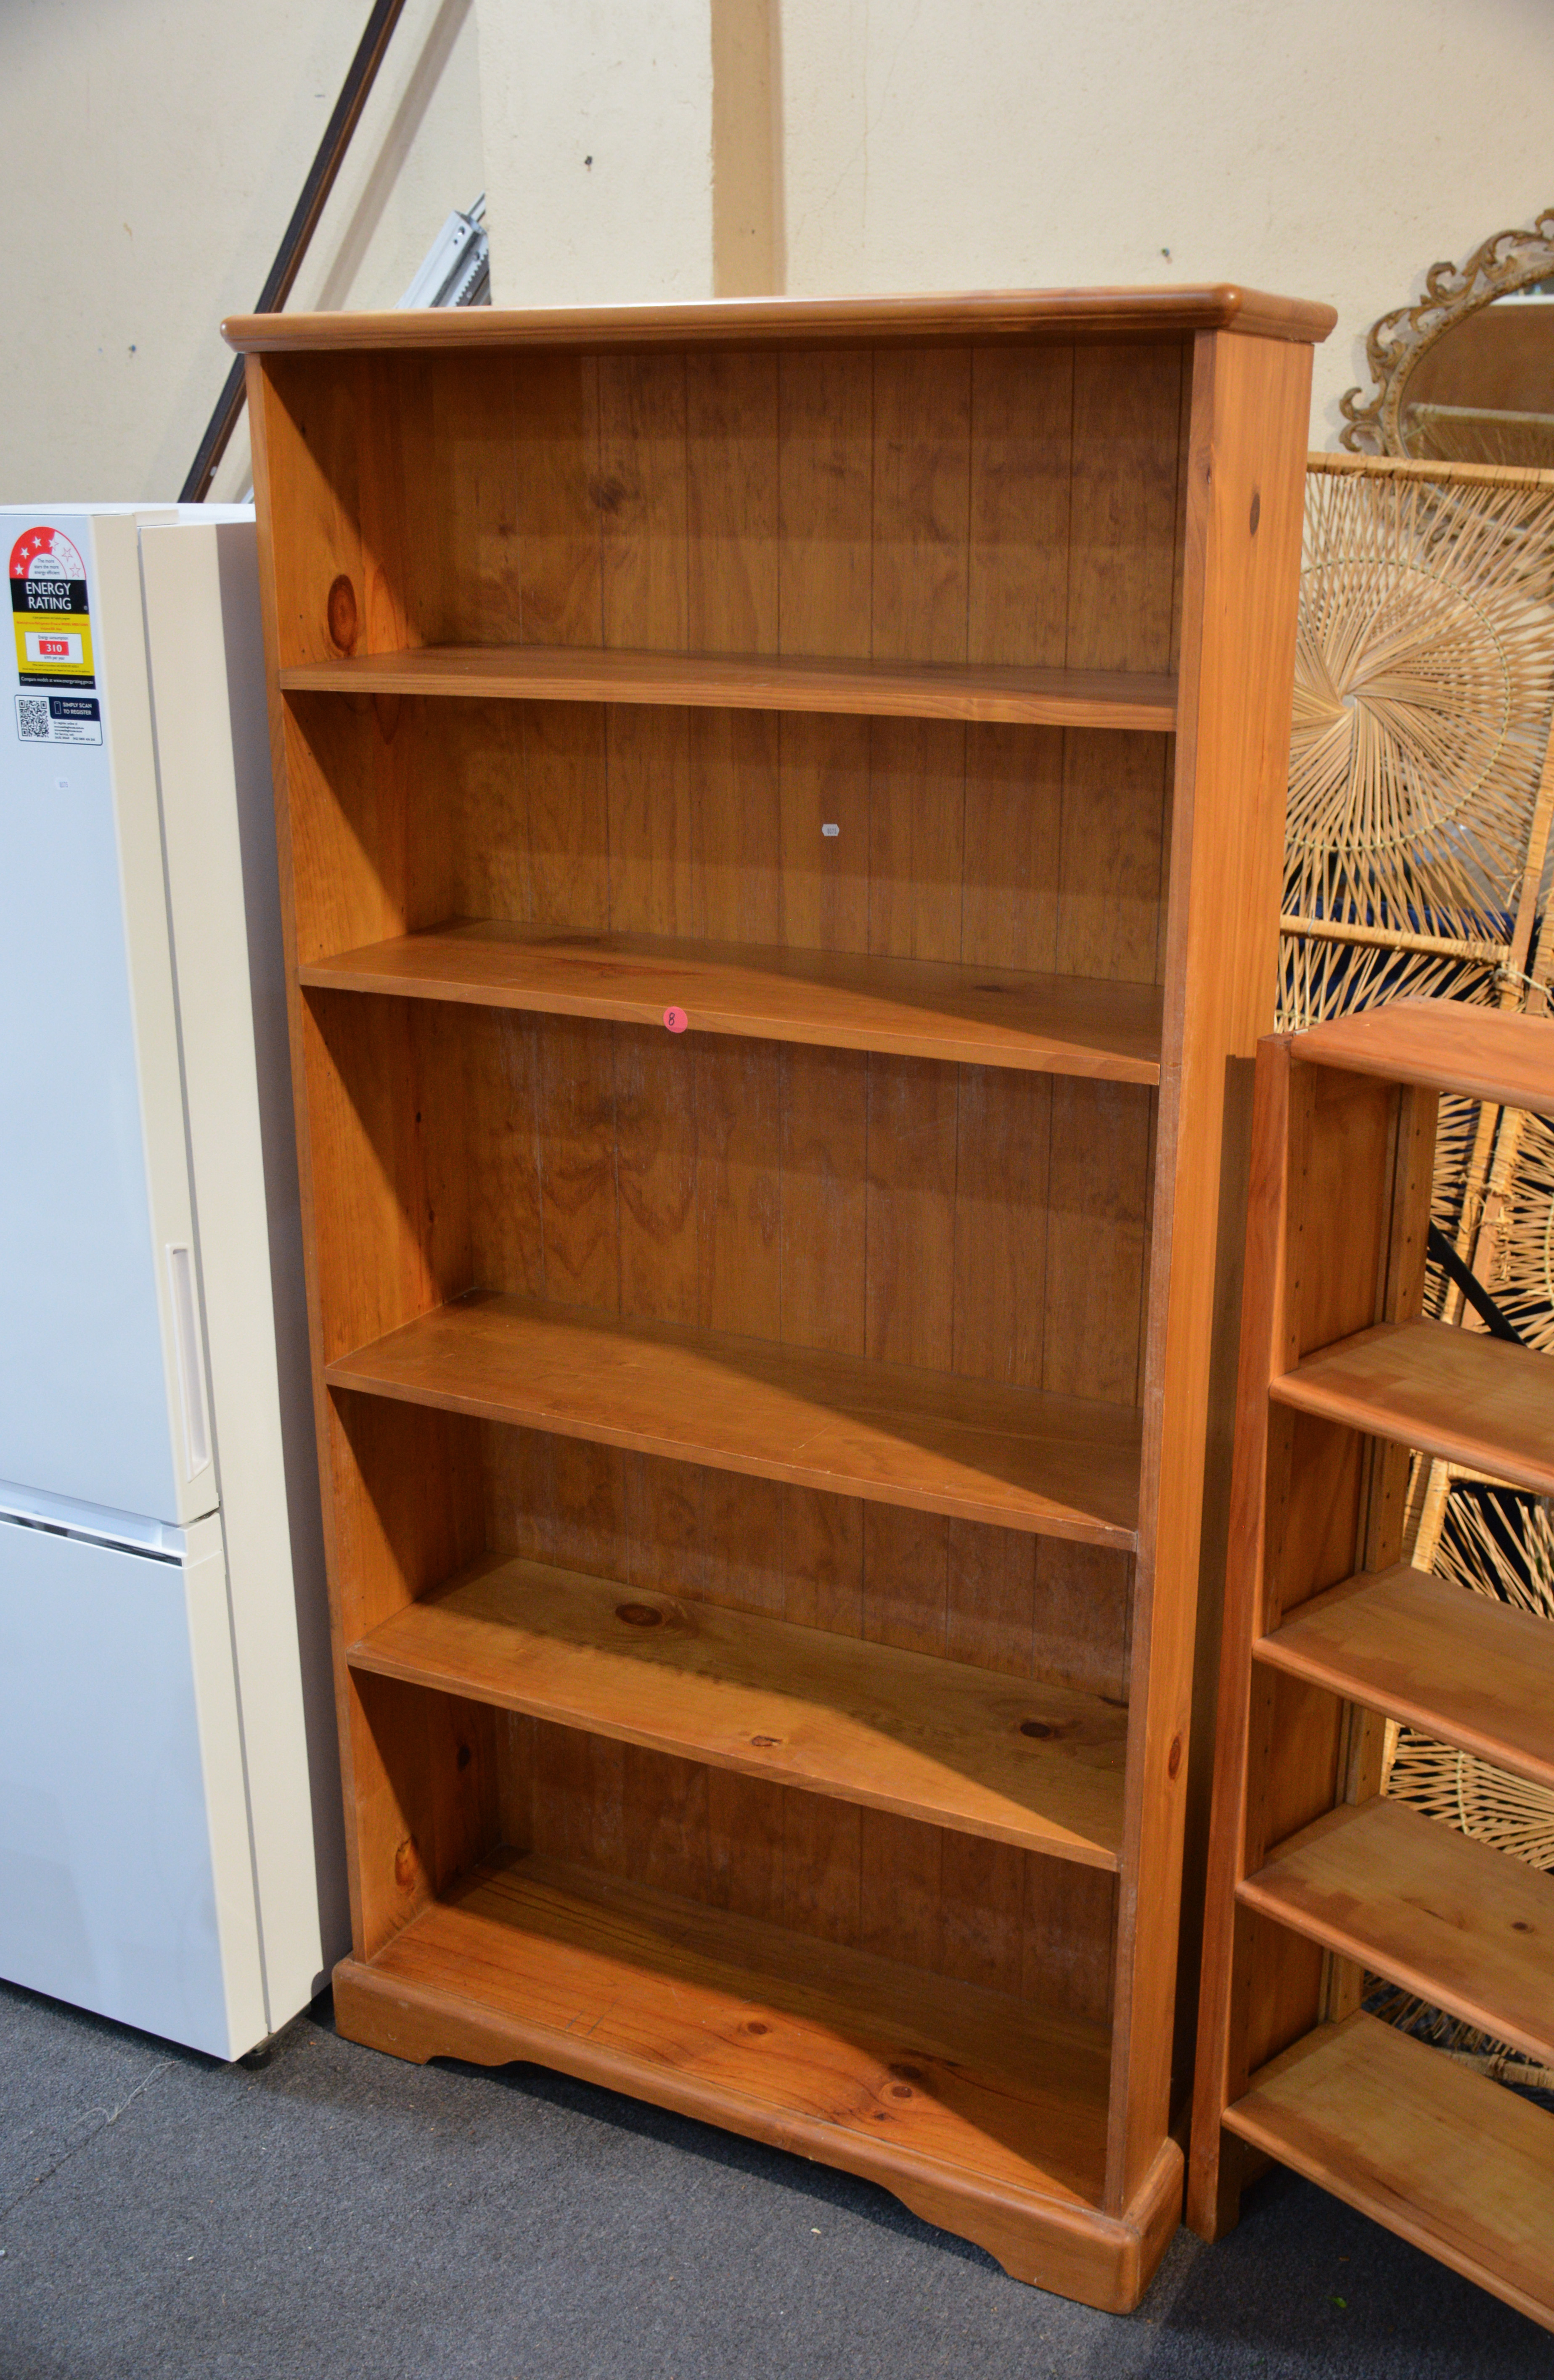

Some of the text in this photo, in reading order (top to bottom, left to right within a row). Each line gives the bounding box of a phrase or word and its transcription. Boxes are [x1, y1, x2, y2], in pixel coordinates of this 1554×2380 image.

[26, 582, 71, 595] ENERGY
[28, 596, 71, 610] RATING
[46, 644, 62, 652] 310
[668, 1012, 675, 1026] 8
